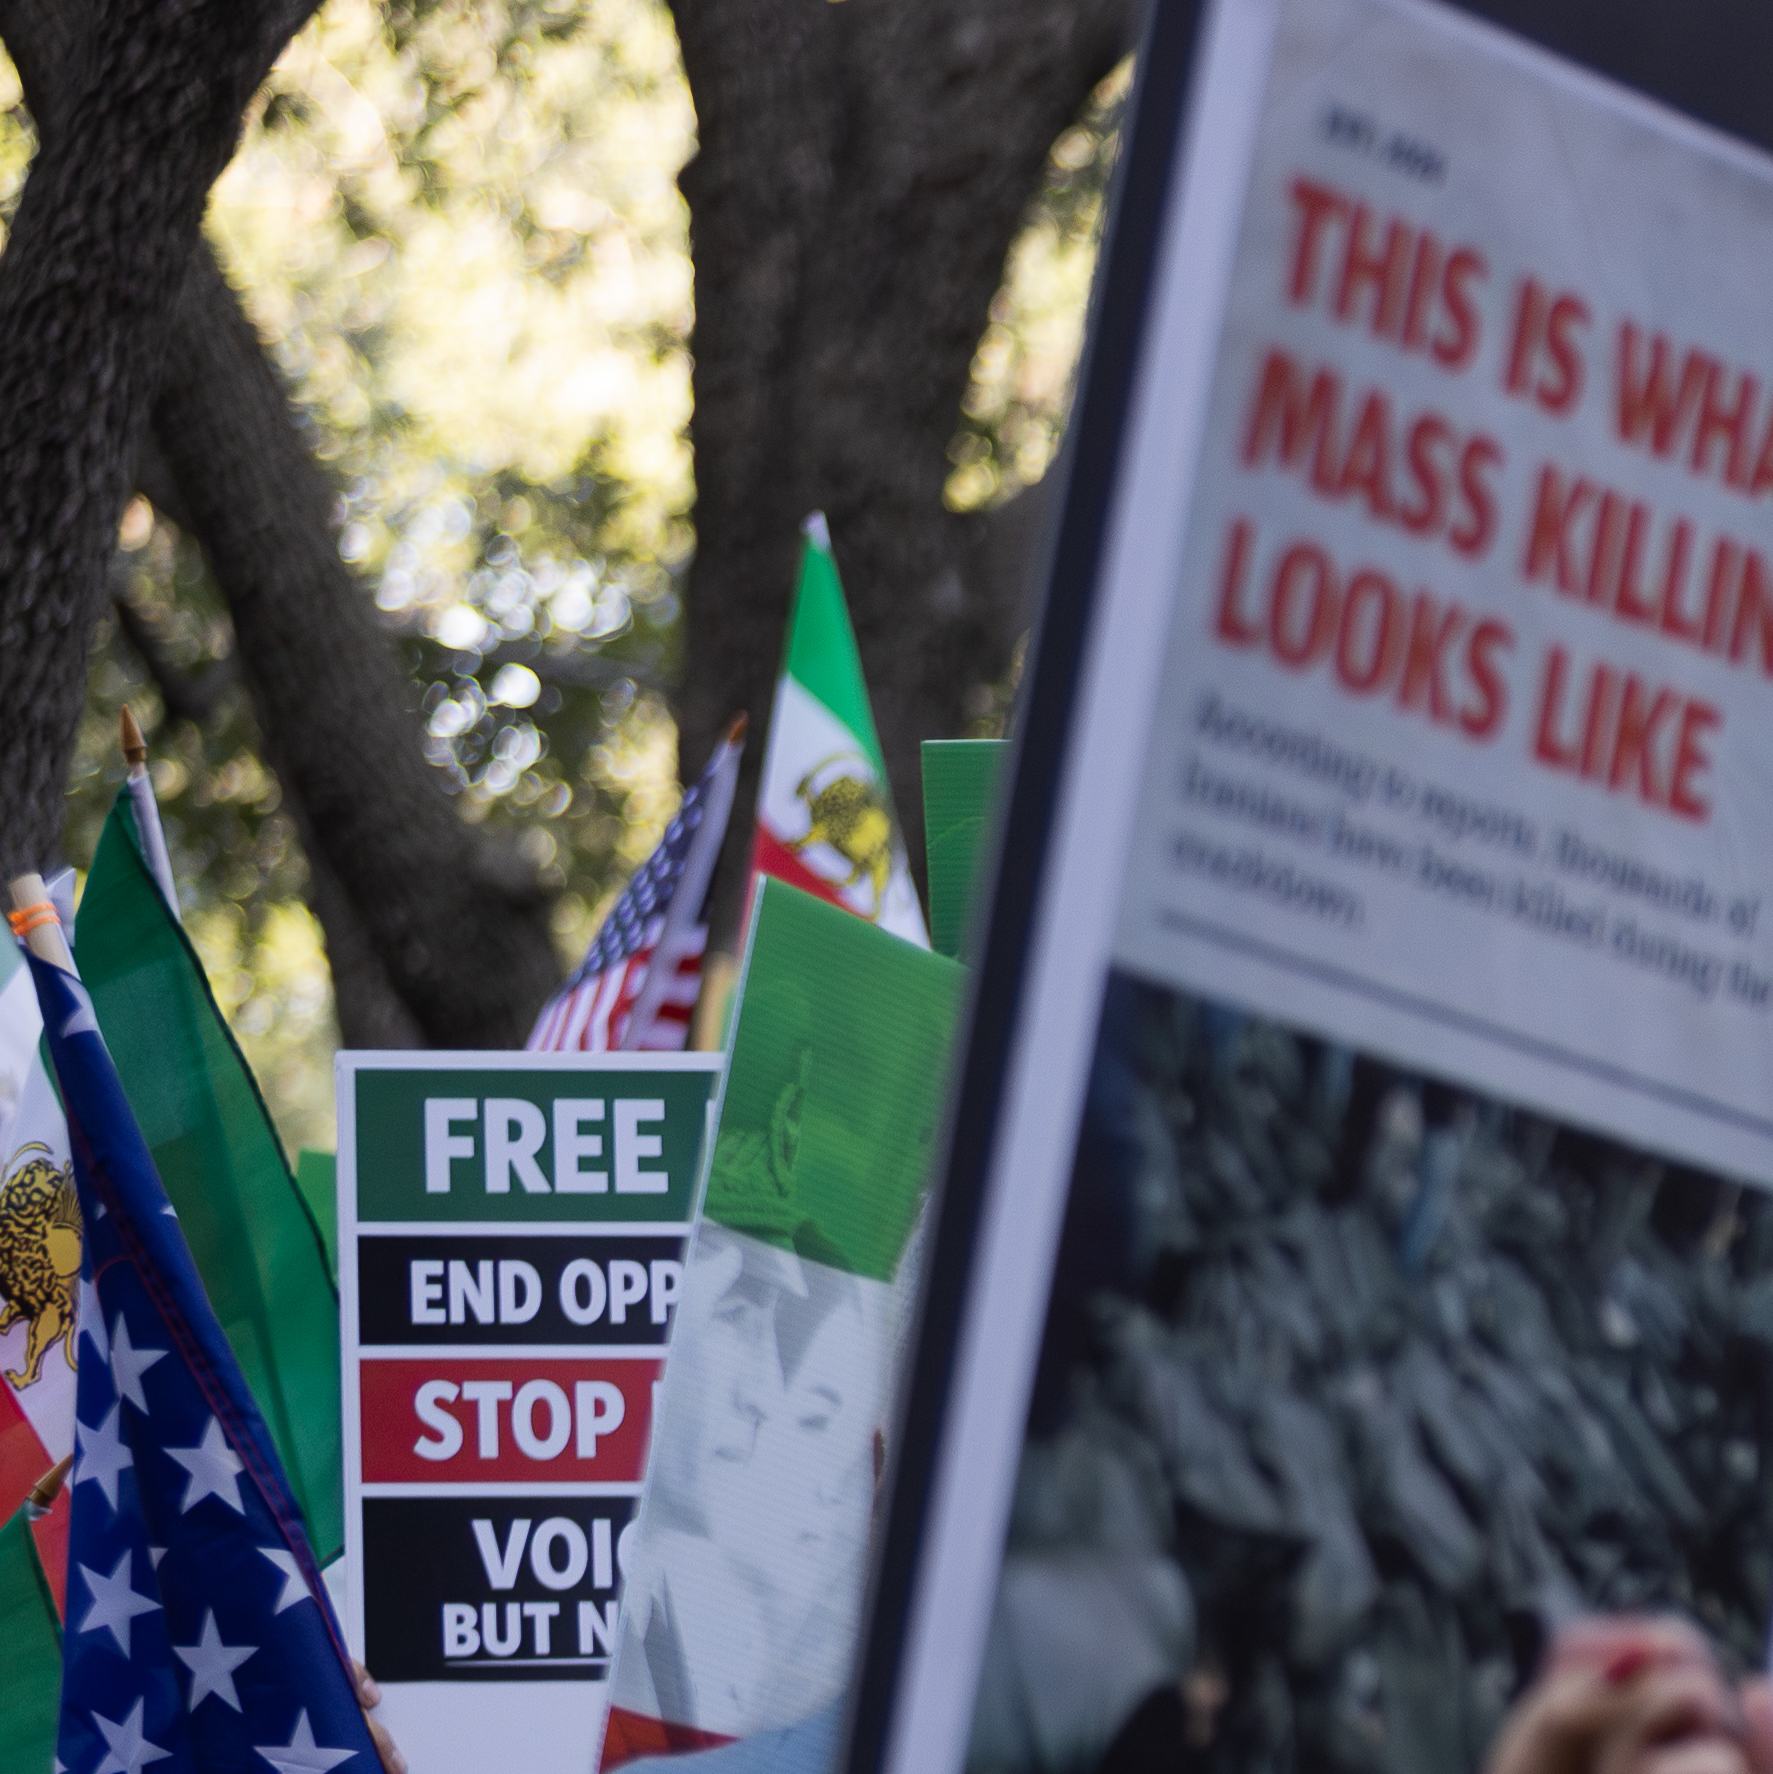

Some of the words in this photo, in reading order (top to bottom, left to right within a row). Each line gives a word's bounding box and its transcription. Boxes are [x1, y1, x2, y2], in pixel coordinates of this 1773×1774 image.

[1285, 170, 1490, 376] THIS
[1503, 272, 1594, 417] IS
[1238, 344, 1509, 561] MASS
[1210, 511, 1516, 745] LOOKS
[1533, 640, 1728, 824] LIKE
[425, 1096, 670, 1195] FREE
[410, 1259, 544, 1326] END
[413, 1378, 627, 1462] STOP
[443, 1601, 561, 1658] BUT
